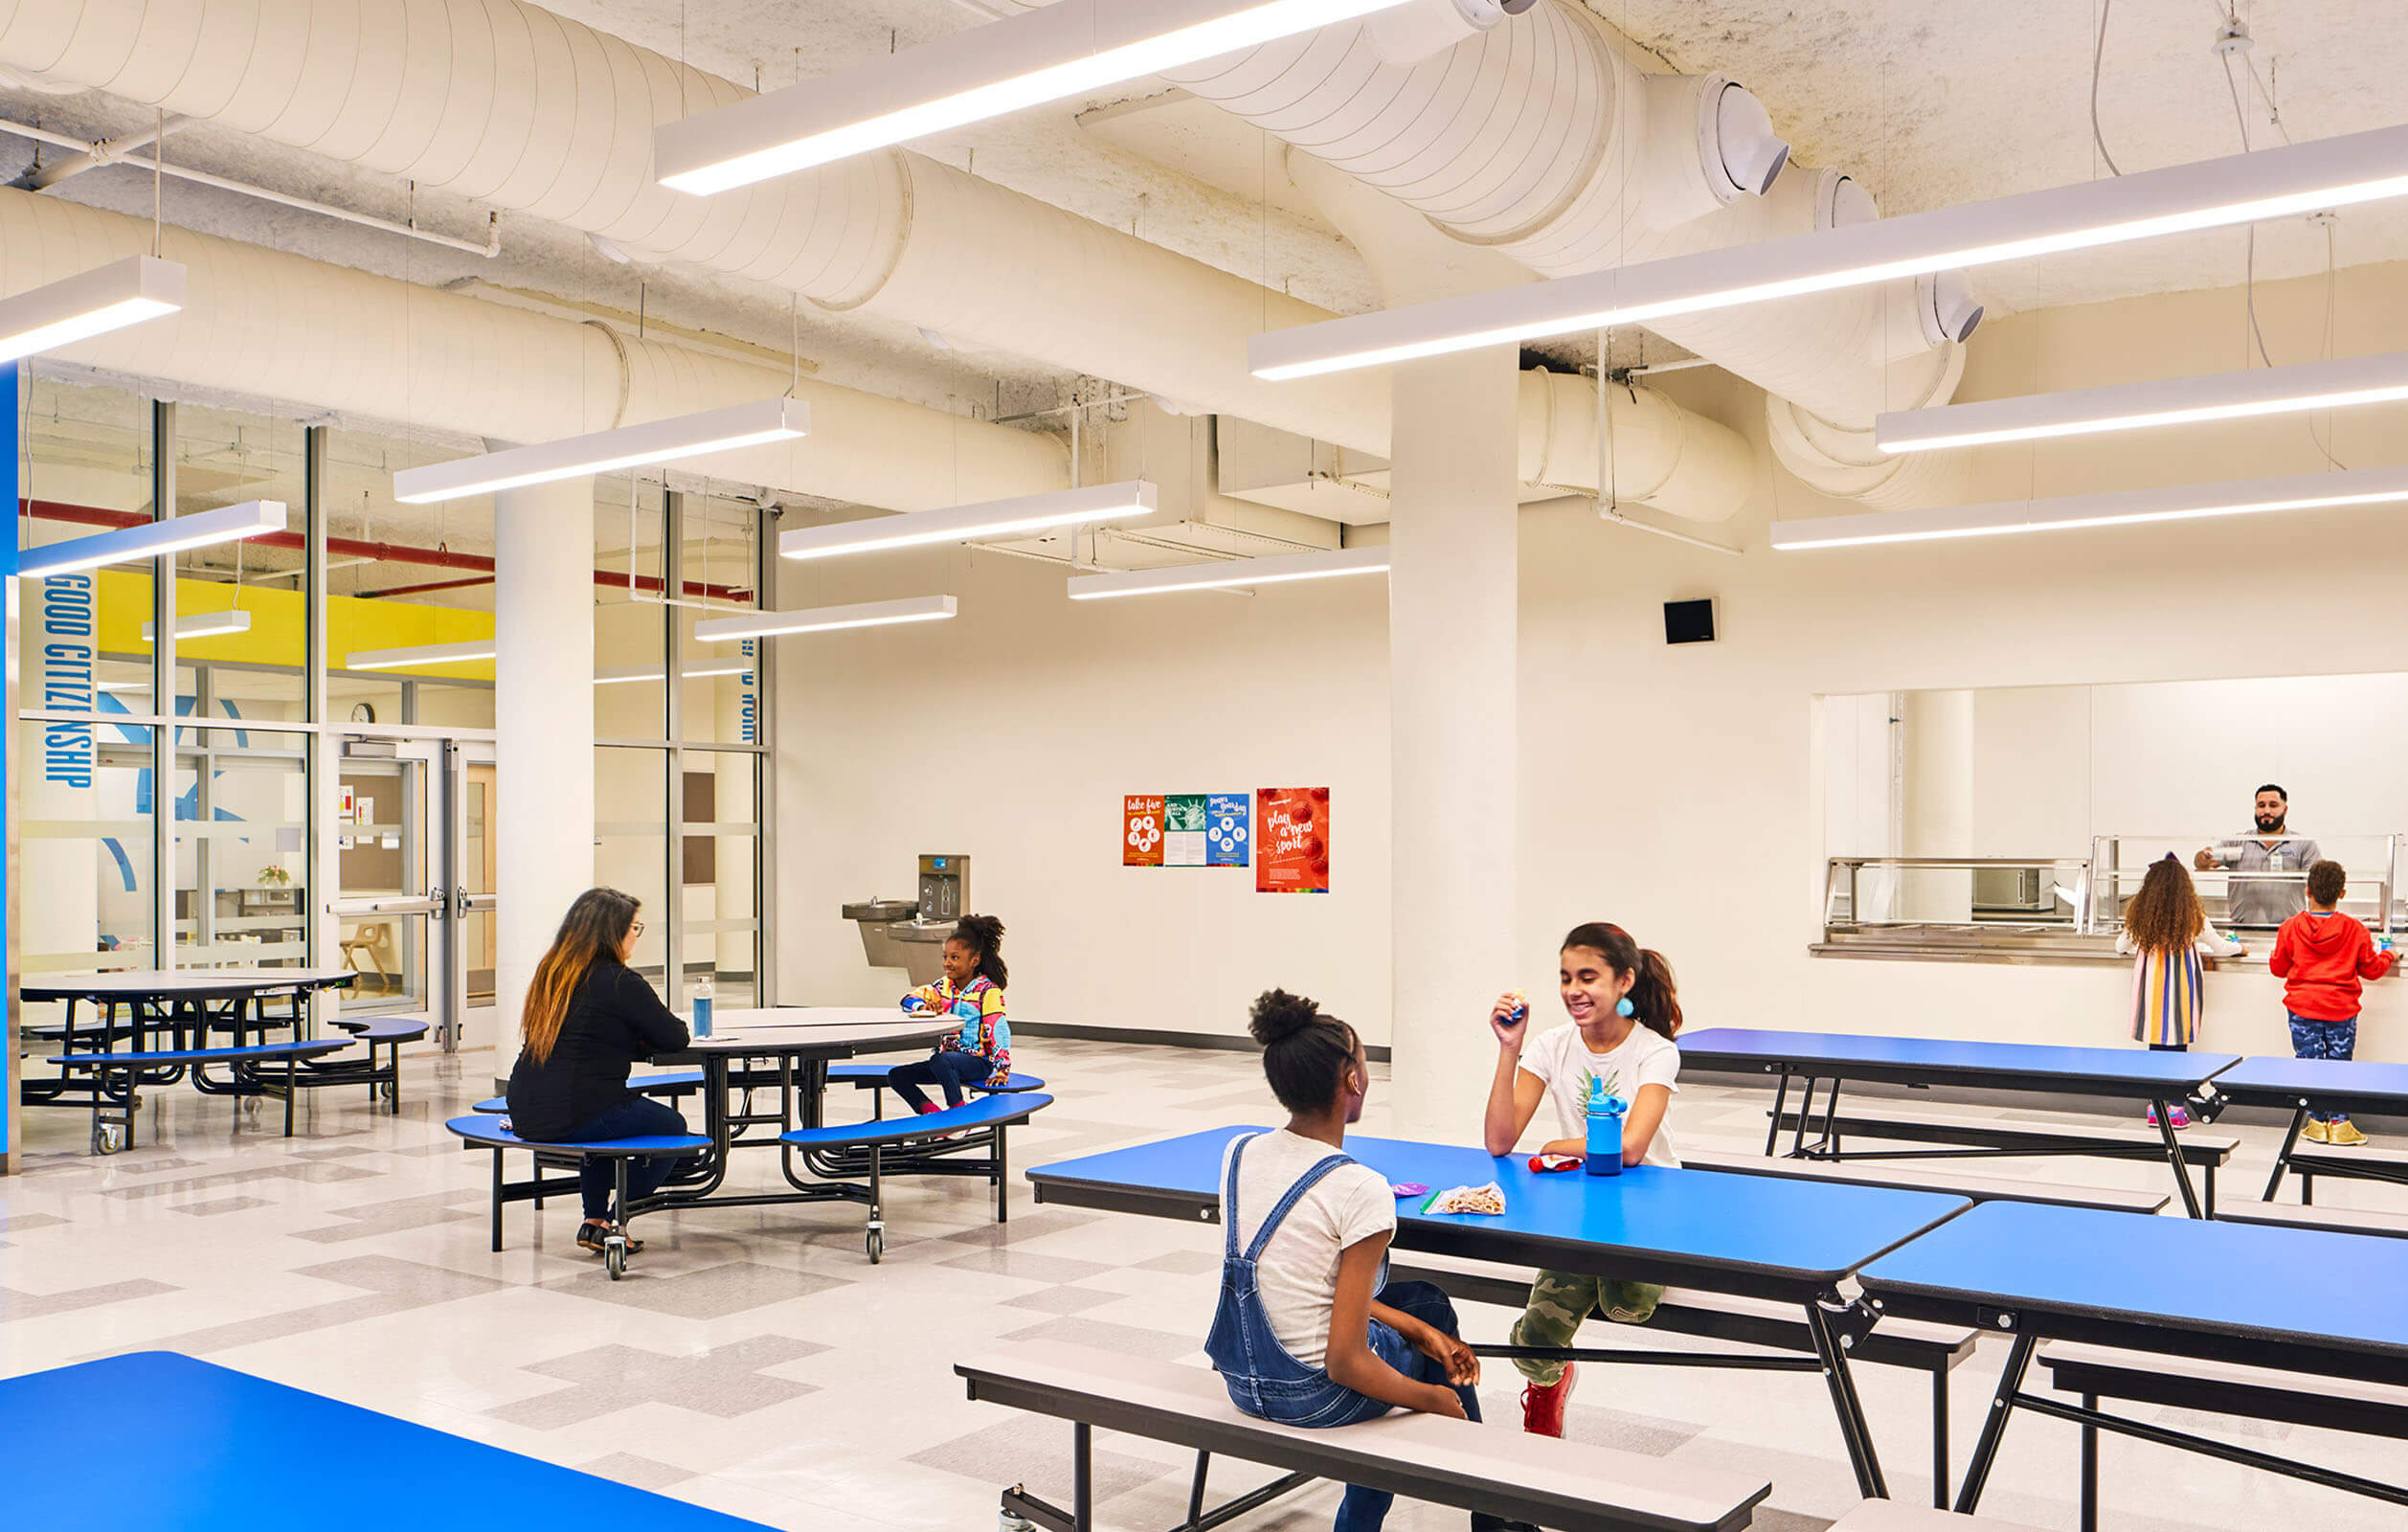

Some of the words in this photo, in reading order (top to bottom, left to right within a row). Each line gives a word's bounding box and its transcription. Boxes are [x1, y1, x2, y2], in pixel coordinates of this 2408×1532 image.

[44, 574, 92, 636] GOOD
[1127, 798, 1145, 811] take
[1146, 798, 1162, 814] five
[1268, 810, 1292, 832] play
[1280, 826, 1288, 837] a
[1291, 820, 1313, 836] new
[1276, 833, 1302, 854] sport
